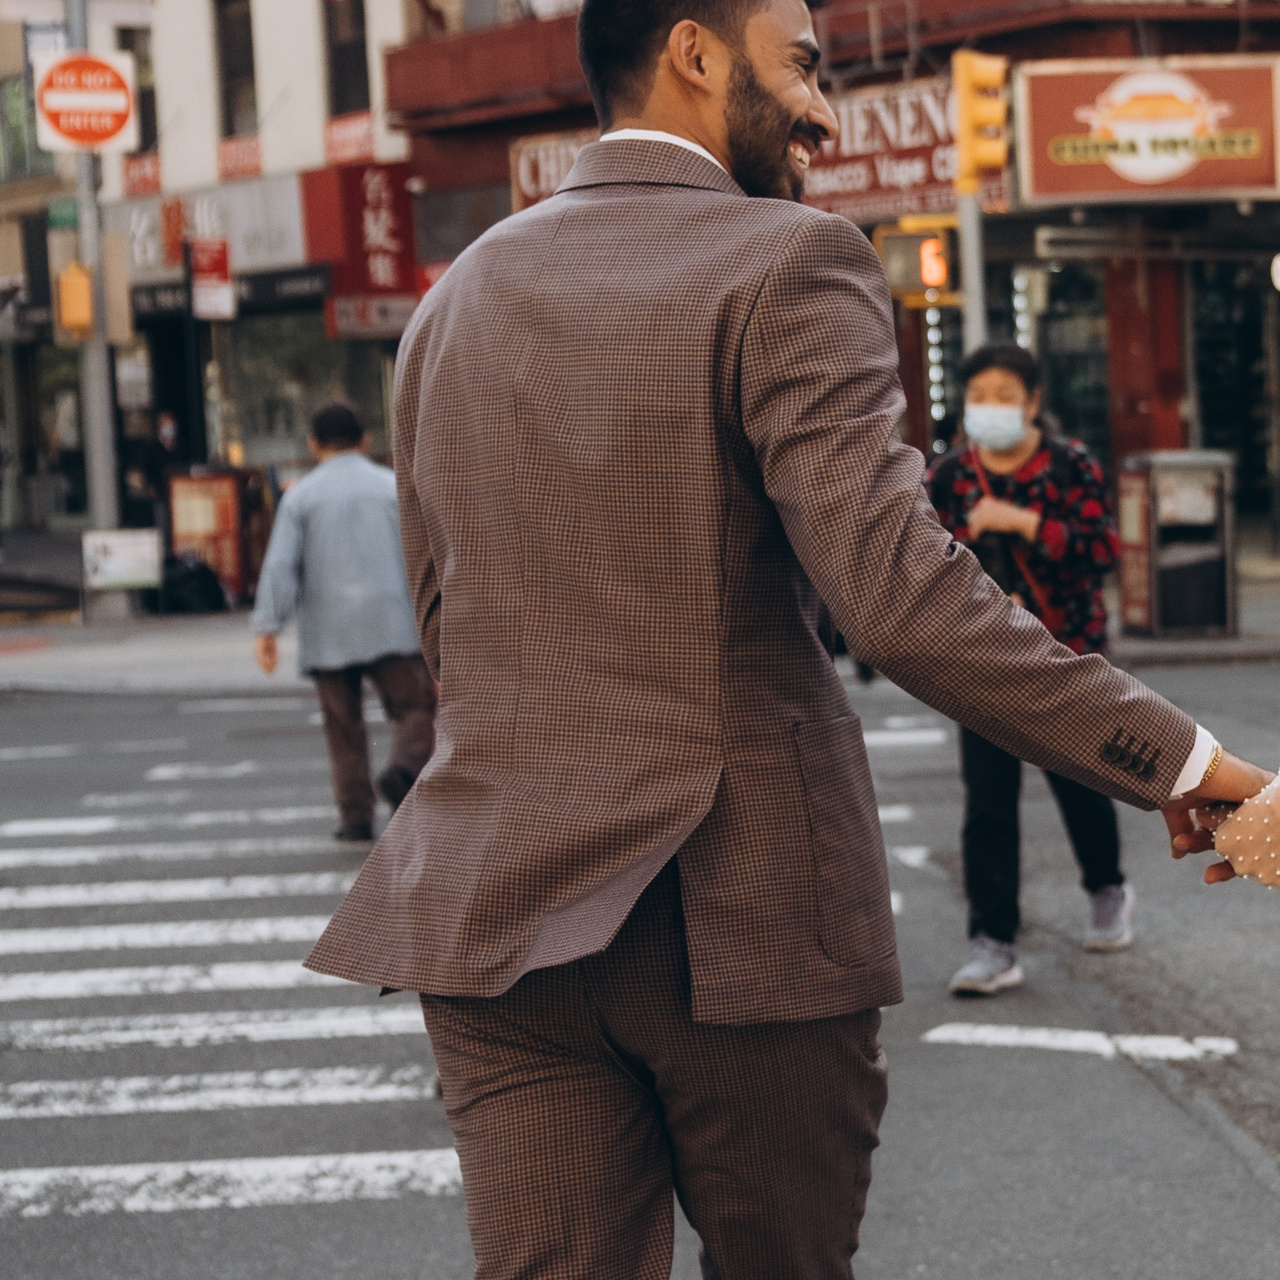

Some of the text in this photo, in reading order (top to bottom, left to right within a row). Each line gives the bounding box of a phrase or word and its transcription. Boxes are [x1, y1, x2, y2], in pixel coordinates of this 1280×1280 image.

[53, 69, 113, 89] DO NOT
[59, 111, 114, 131] ENTER
[920, 238, 947, 288] 6
